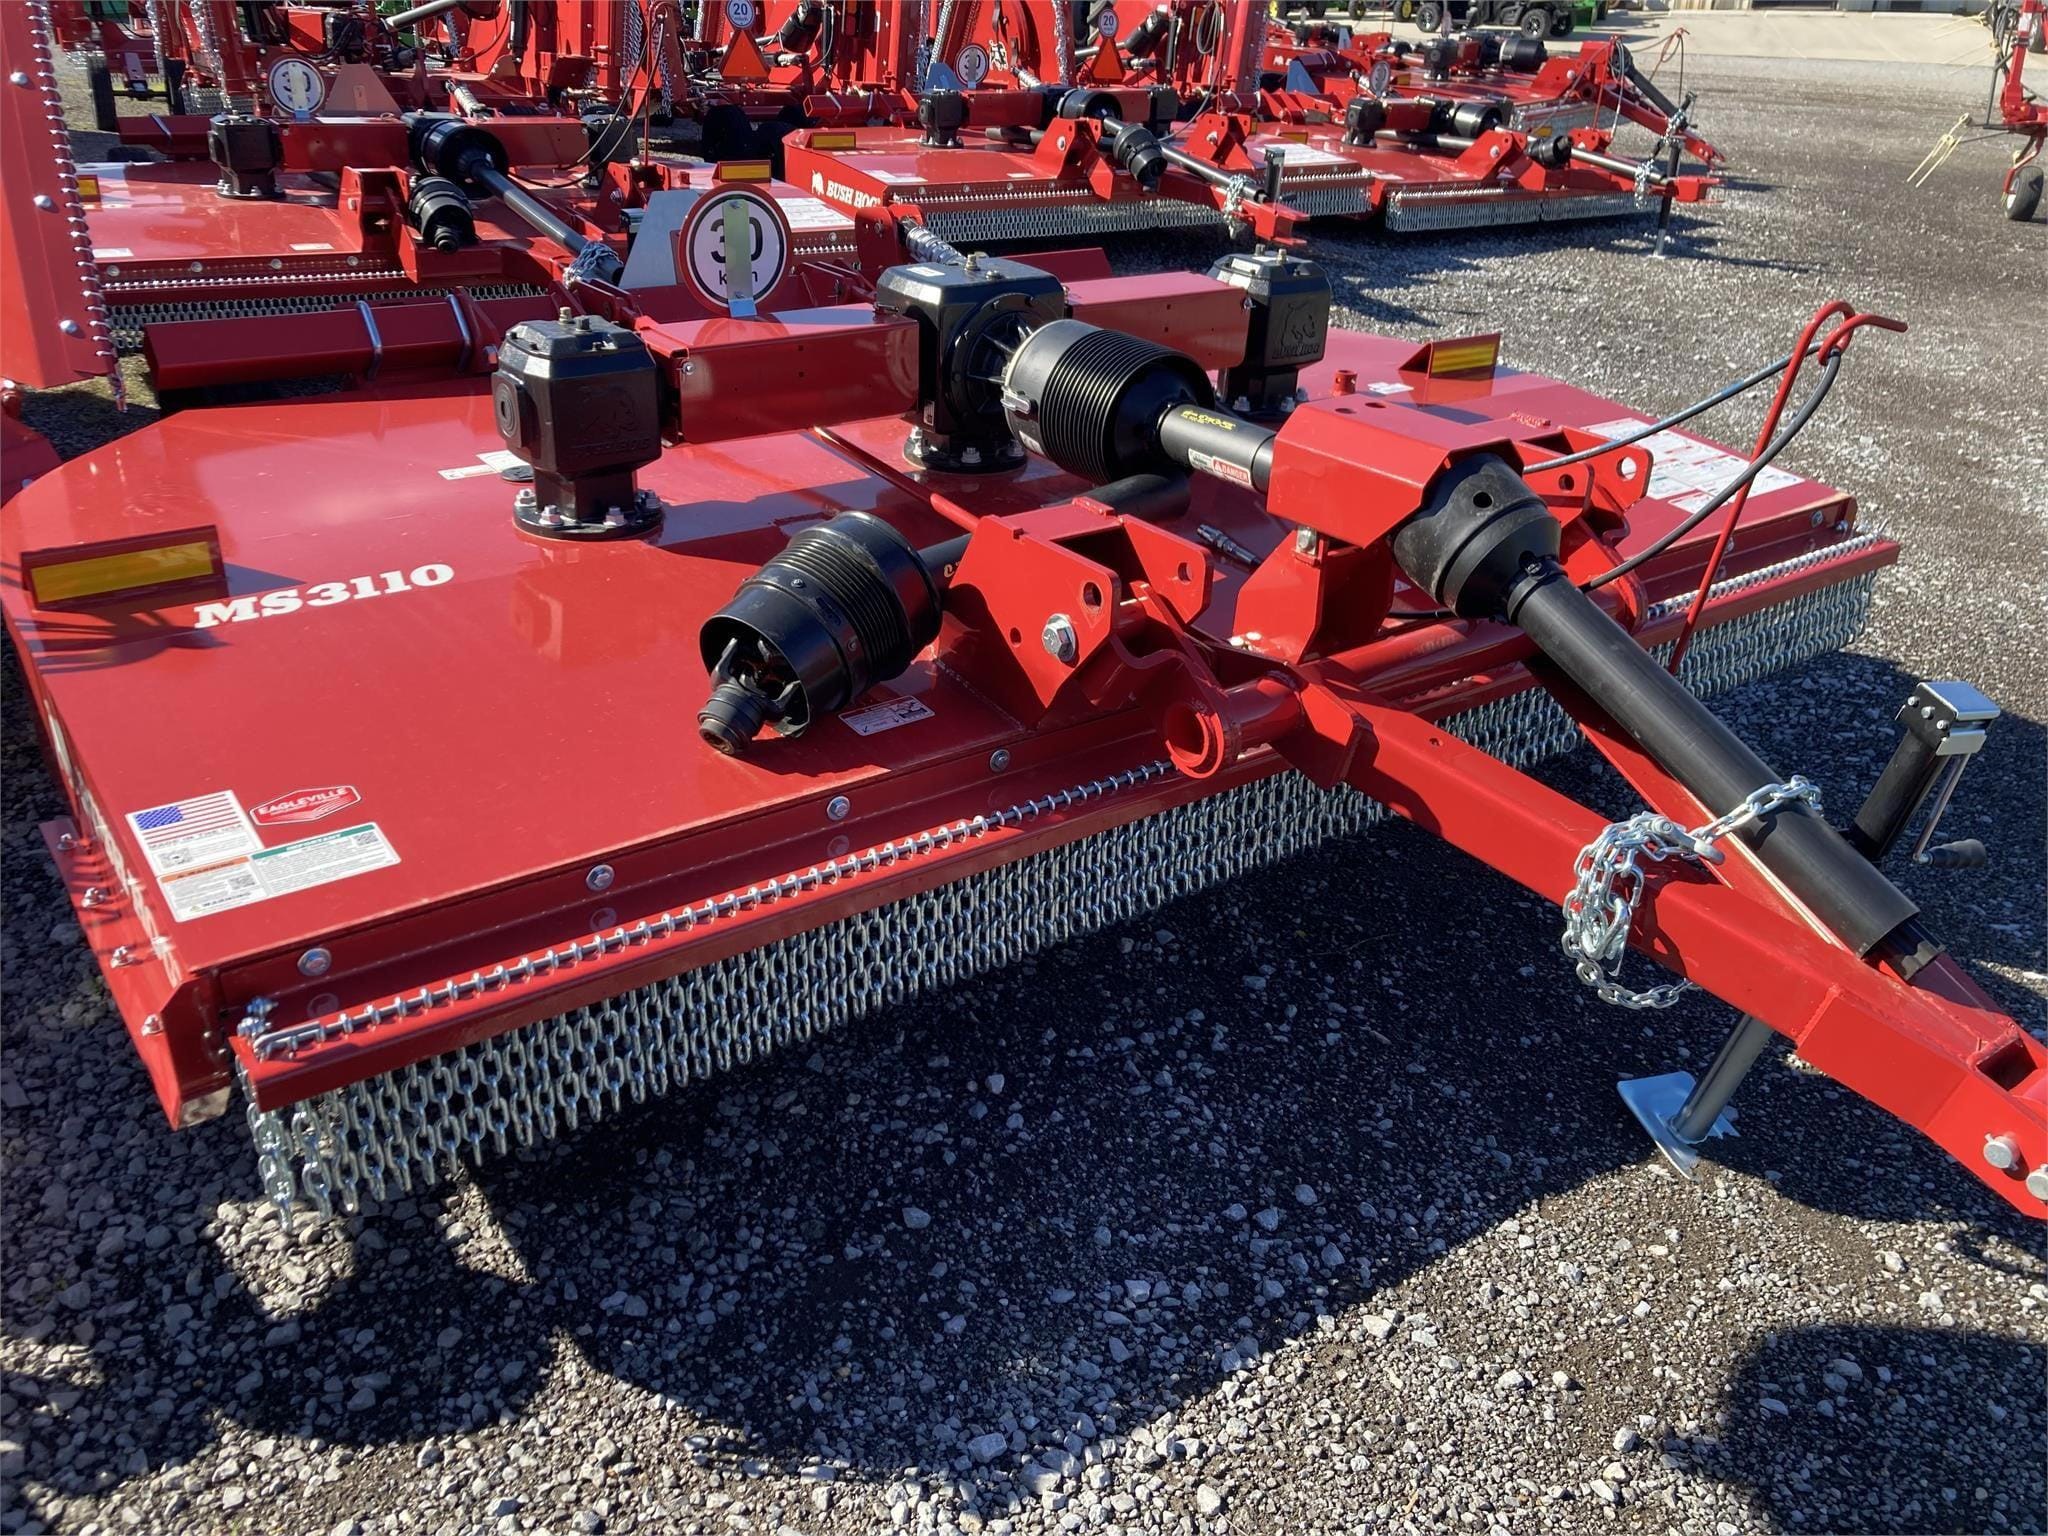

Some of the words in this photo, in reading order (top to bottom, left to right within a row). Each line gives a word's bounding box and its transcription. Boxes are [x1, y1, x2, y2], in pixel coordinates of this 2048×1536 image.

[733, 3, 748, 15] 20
[1103, 15, 1114, 26] 20
[826, 180, 854, 205] BUSH
[194, 563, 455, 629] MS3110
[258, 787, 348, 815] EAGLEVILLE
